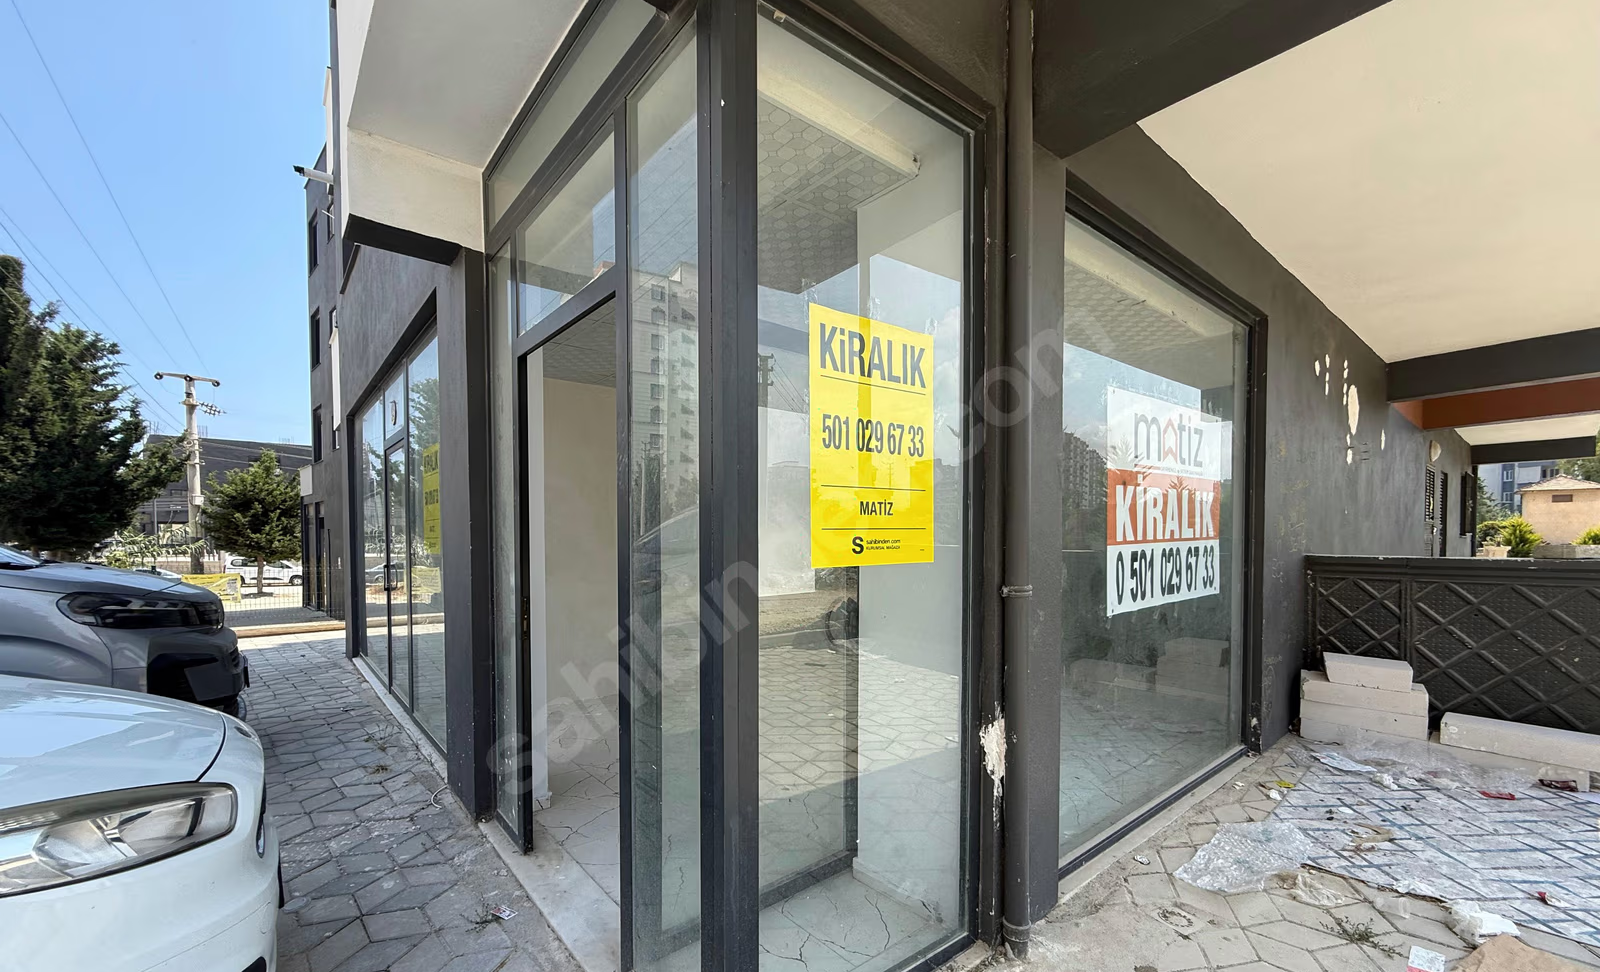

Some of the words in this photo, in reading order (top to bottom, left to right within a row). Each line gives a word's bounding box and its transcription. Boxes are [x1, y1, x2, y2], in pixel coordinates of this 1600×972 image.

[822, 413, 850, 450] 501
[856, 418, 883, 454] 029
[887, 422, 905, 456] 67
[908, 425, 925, 458] 33
[859, 499, 894, 517] MATİZ
[1115, 474, 1215, 542] KİRALIK
[1116, 550, 1125, 606] 0
[1130, 548, 1154, 603] 501
[1160, 547, 1182, 598] 029
[1185, 546, 1200, 593] 67
[1202, 545, 1215, 590] 33
